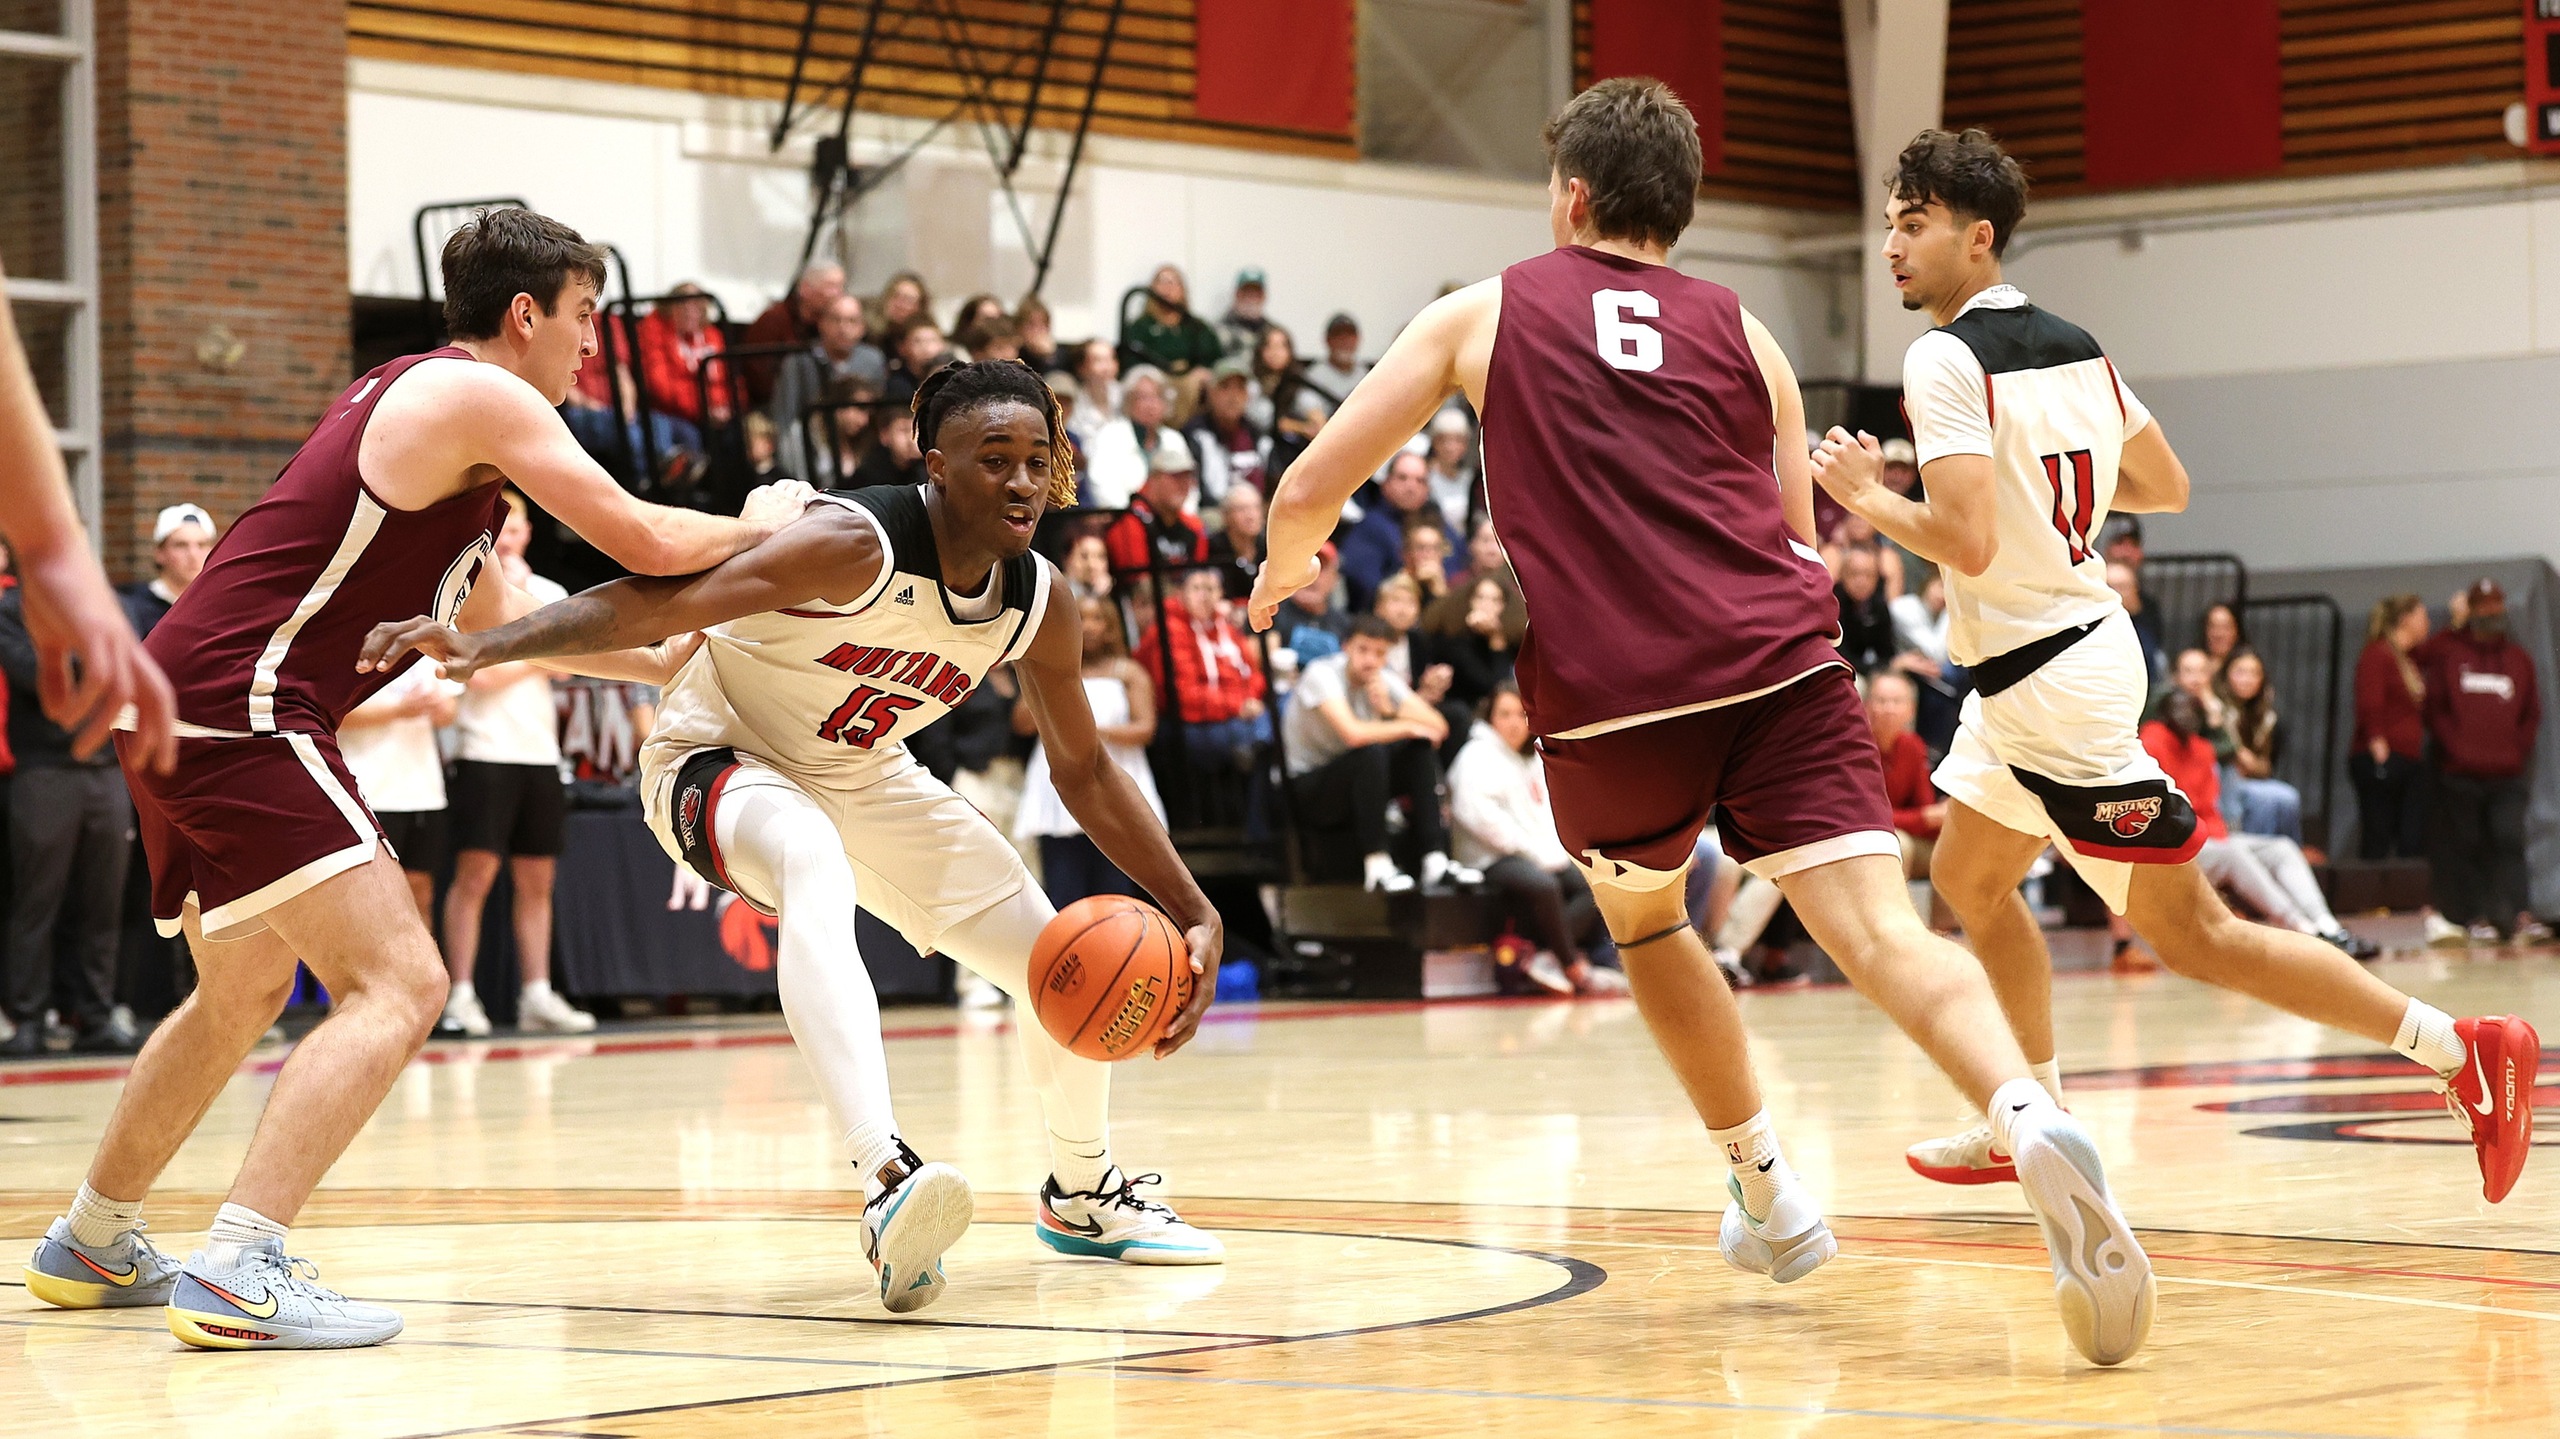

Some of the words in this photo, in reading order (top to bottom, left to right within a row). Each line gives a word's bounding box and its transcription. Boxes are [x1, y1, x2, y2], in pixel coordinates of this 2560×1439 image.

[1592, 288, 1664, 373] 6
[2040, 448, 2095, 567] 11
[817, 683, 926, 750] 15
[2093, 796, 2163, 822] MUSTANGS
[1103, 975, 1163, 1055] LEGACY
